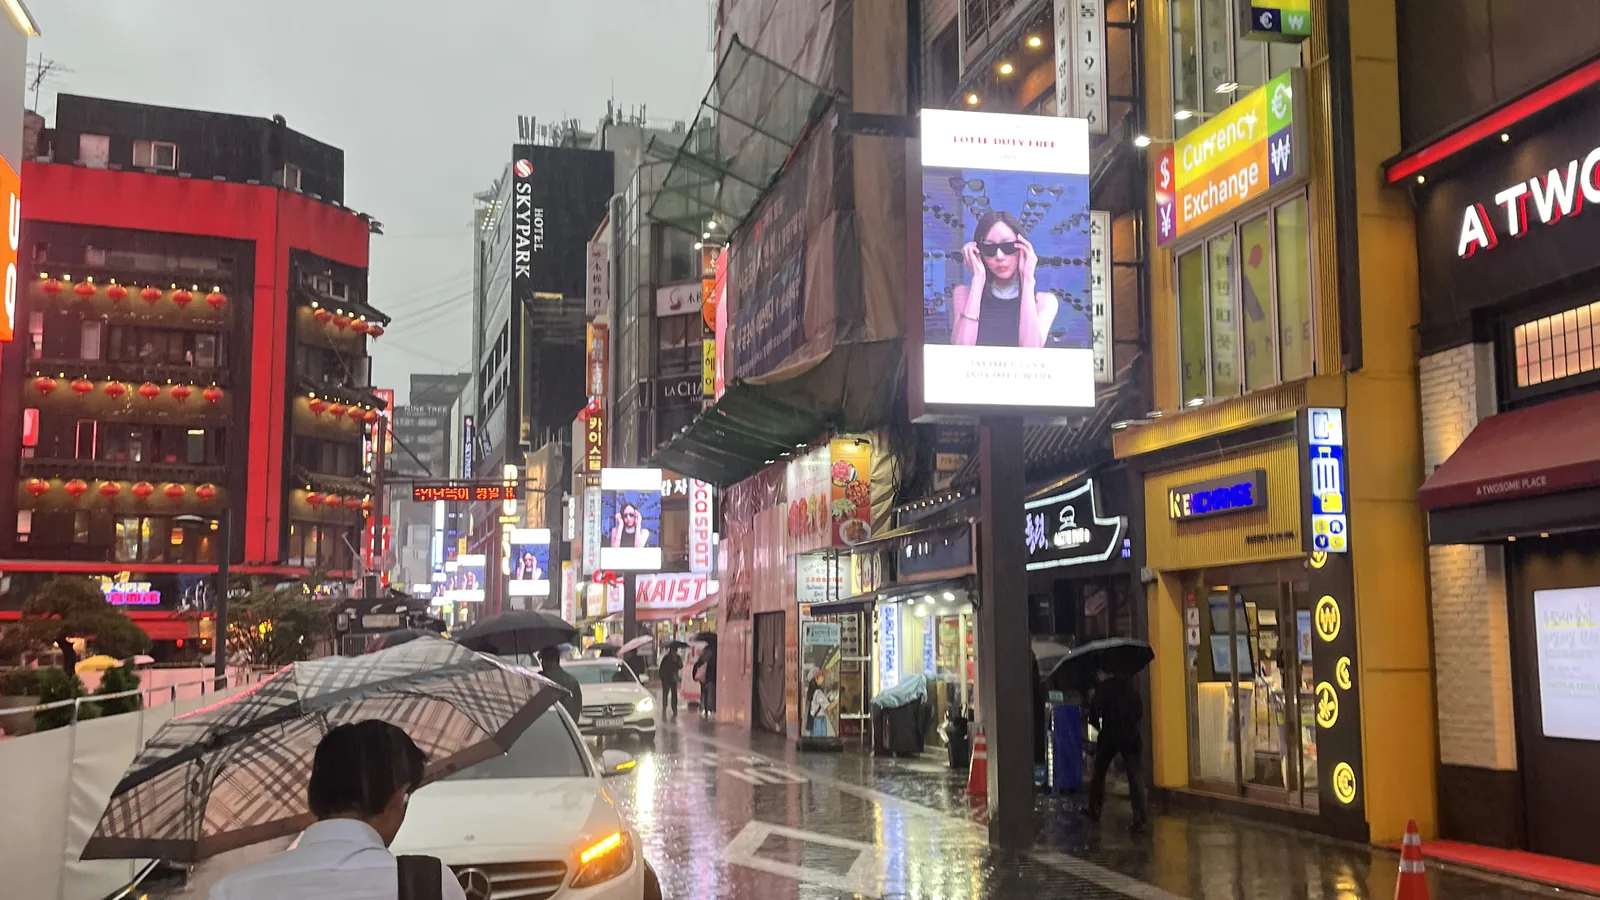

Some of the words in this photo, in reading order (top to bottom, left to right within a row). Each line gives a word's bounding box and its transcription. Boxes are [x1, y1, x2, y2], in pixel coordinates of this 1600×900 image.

[993, 138, 1024, 147] DUTY
[1028, 140, 1055, 148] FREE
[1181, 108, 1258, 172] Currency
[1183, 161, 1259, 222] Exchange
[515, 182, 532, 279] SKYPARK
[534, 208, 544, 252] HOTEL
[1457, 204, 1491, 258] A
[1476, 486, 1482, 495] A
[1482, 479, 1520, 495] TWOSOME
[1521, 475, 1547, 488] PLACE
[635, 577, 706, 603] KAIST
